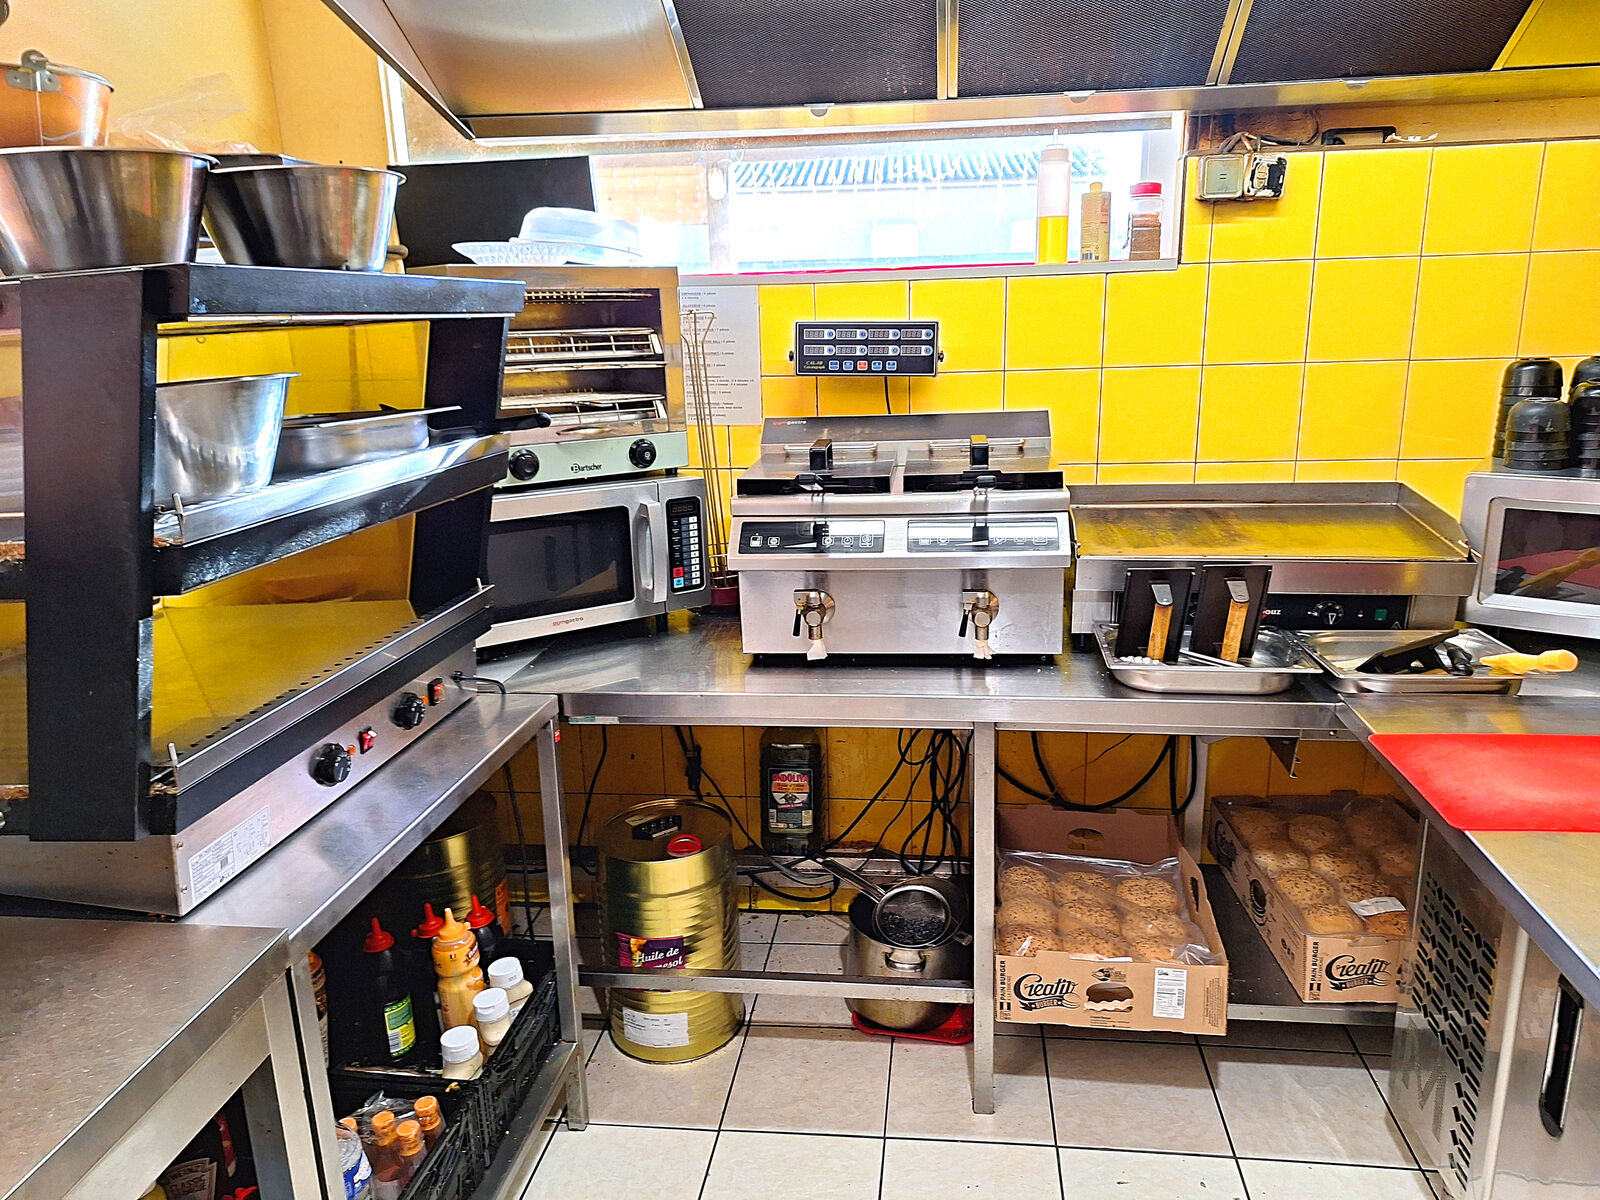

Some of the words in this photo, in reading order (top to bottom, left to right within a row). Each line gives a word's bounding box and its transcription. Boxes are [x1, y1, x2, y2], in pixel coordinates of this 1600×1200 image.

[571, 463, 602, 473] Bartscher
[636, 951, 664, 963] Huile
[666, 948, 679, 957] de
